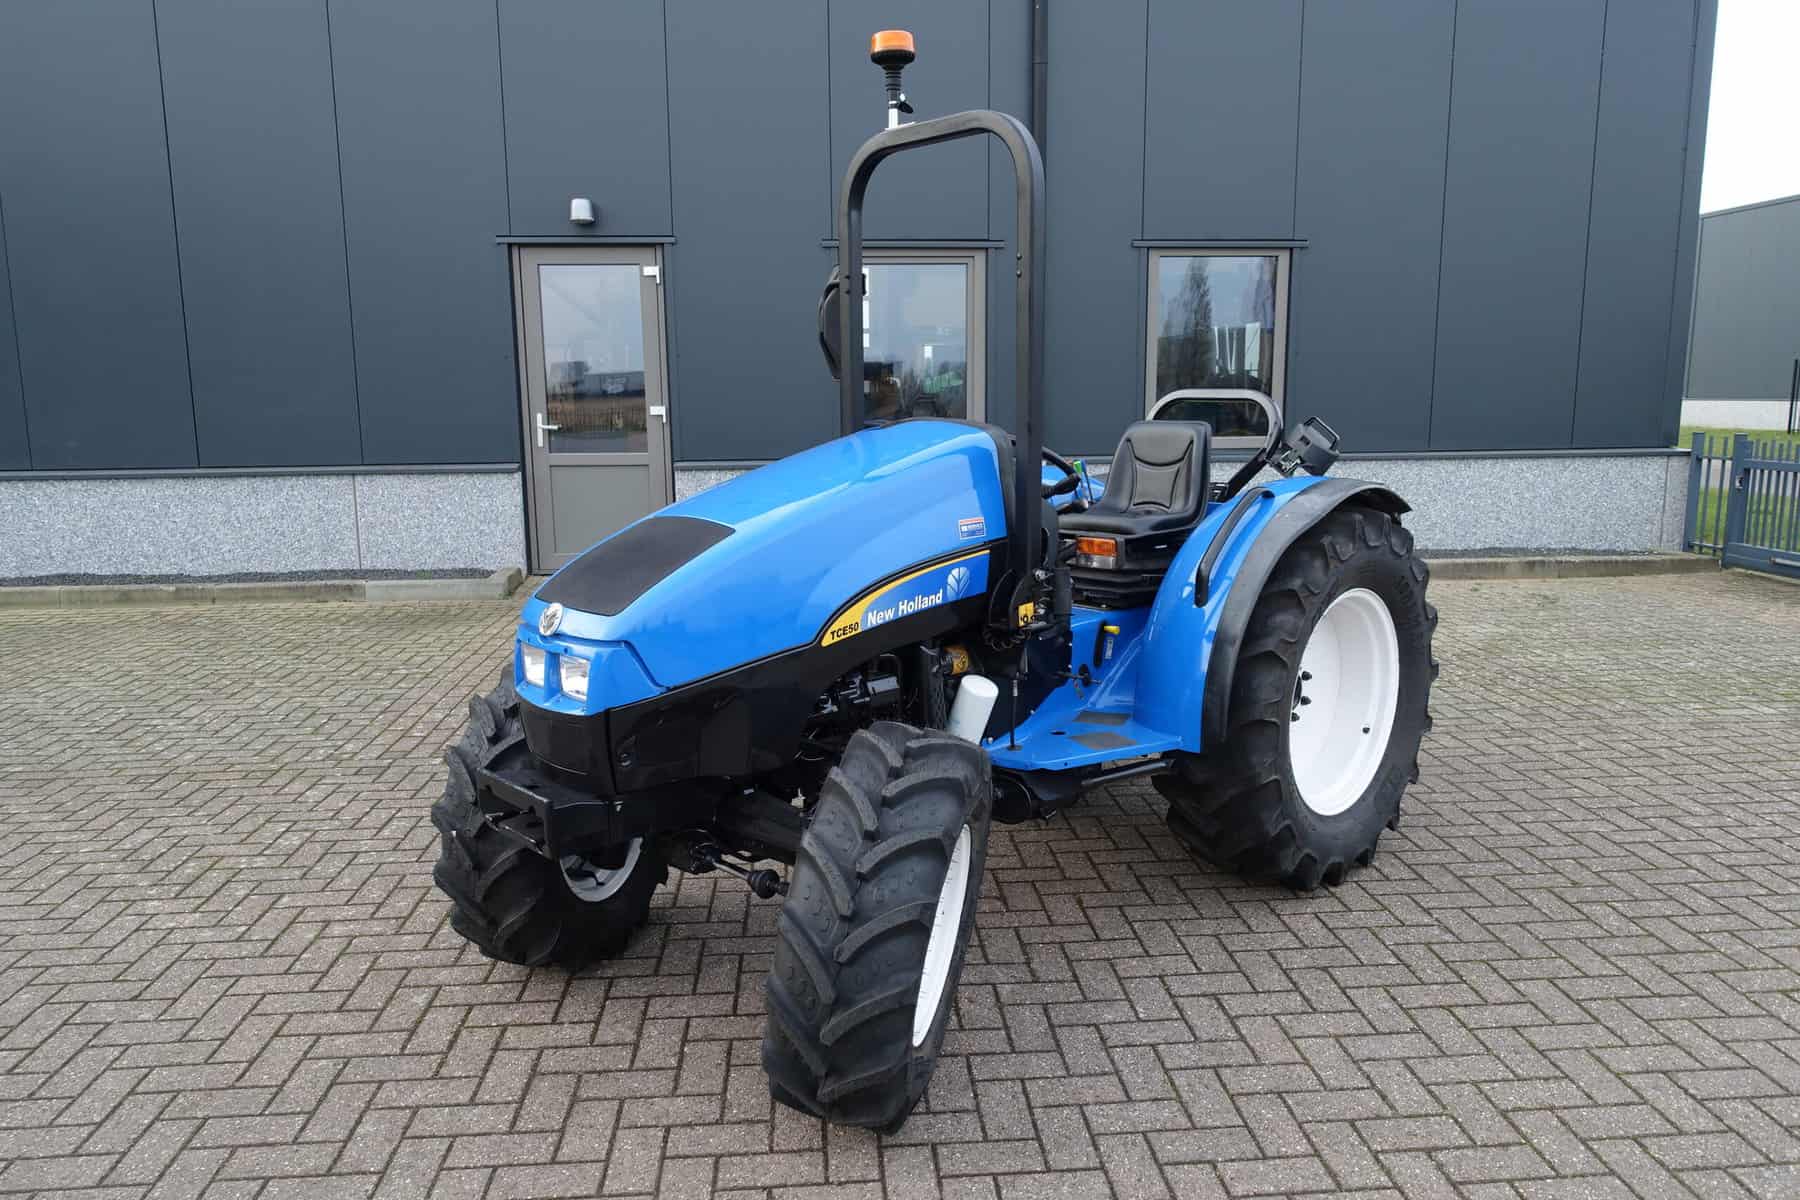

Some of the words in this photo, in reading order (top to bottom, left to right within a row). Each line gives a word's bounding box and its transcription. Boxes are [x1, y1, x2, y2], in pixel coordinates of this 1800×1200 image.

[867, 607, 896, 627] New
[898, 588, 943, 616] Holland
[830, 622, 860, 641] TCE50
